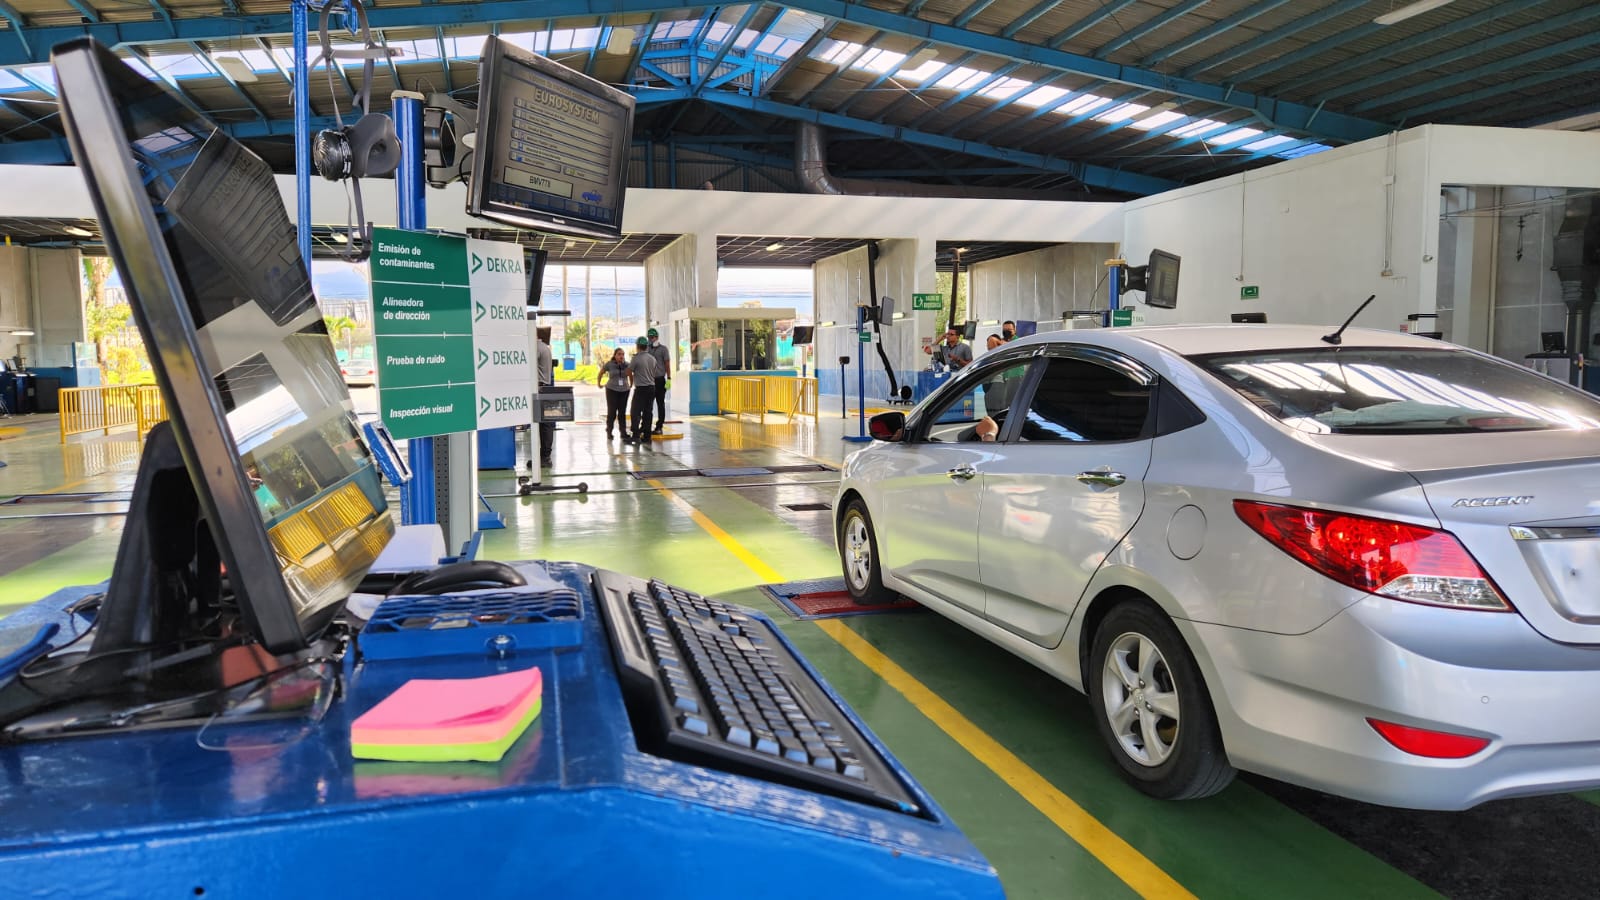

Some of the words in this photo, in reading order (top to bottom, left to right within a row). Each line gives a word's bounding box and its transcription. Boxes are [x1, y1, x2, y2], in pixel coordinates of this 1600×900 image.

[534, 87, 600, 125] EUROSYSTEM
[378, 242, 410, 255] Emisión
[411, 246, 421, 255] de
[379, 258, 435, 270] contaminantes
[487, 257, 522, 274] DEKRA
[382, 296, 424, 307] Alineadora
[383, 310, 394, 320] de
[395, 310, 430, 320] dirección
[490, 304, 525, 320] DEKRA
[387, 355, 414, 365] Prueba
[415, 355, 425, 364] de
[426, 354, 446, 364] ruido
[493, 350, 527, 365] DEKRA
[495, 395, 528, 412] DEKRA
[390, 405, 431, 419] Inspección
[432, 403, 453, 413] visual
[1452, 495, 1535, 507] ACCENT
